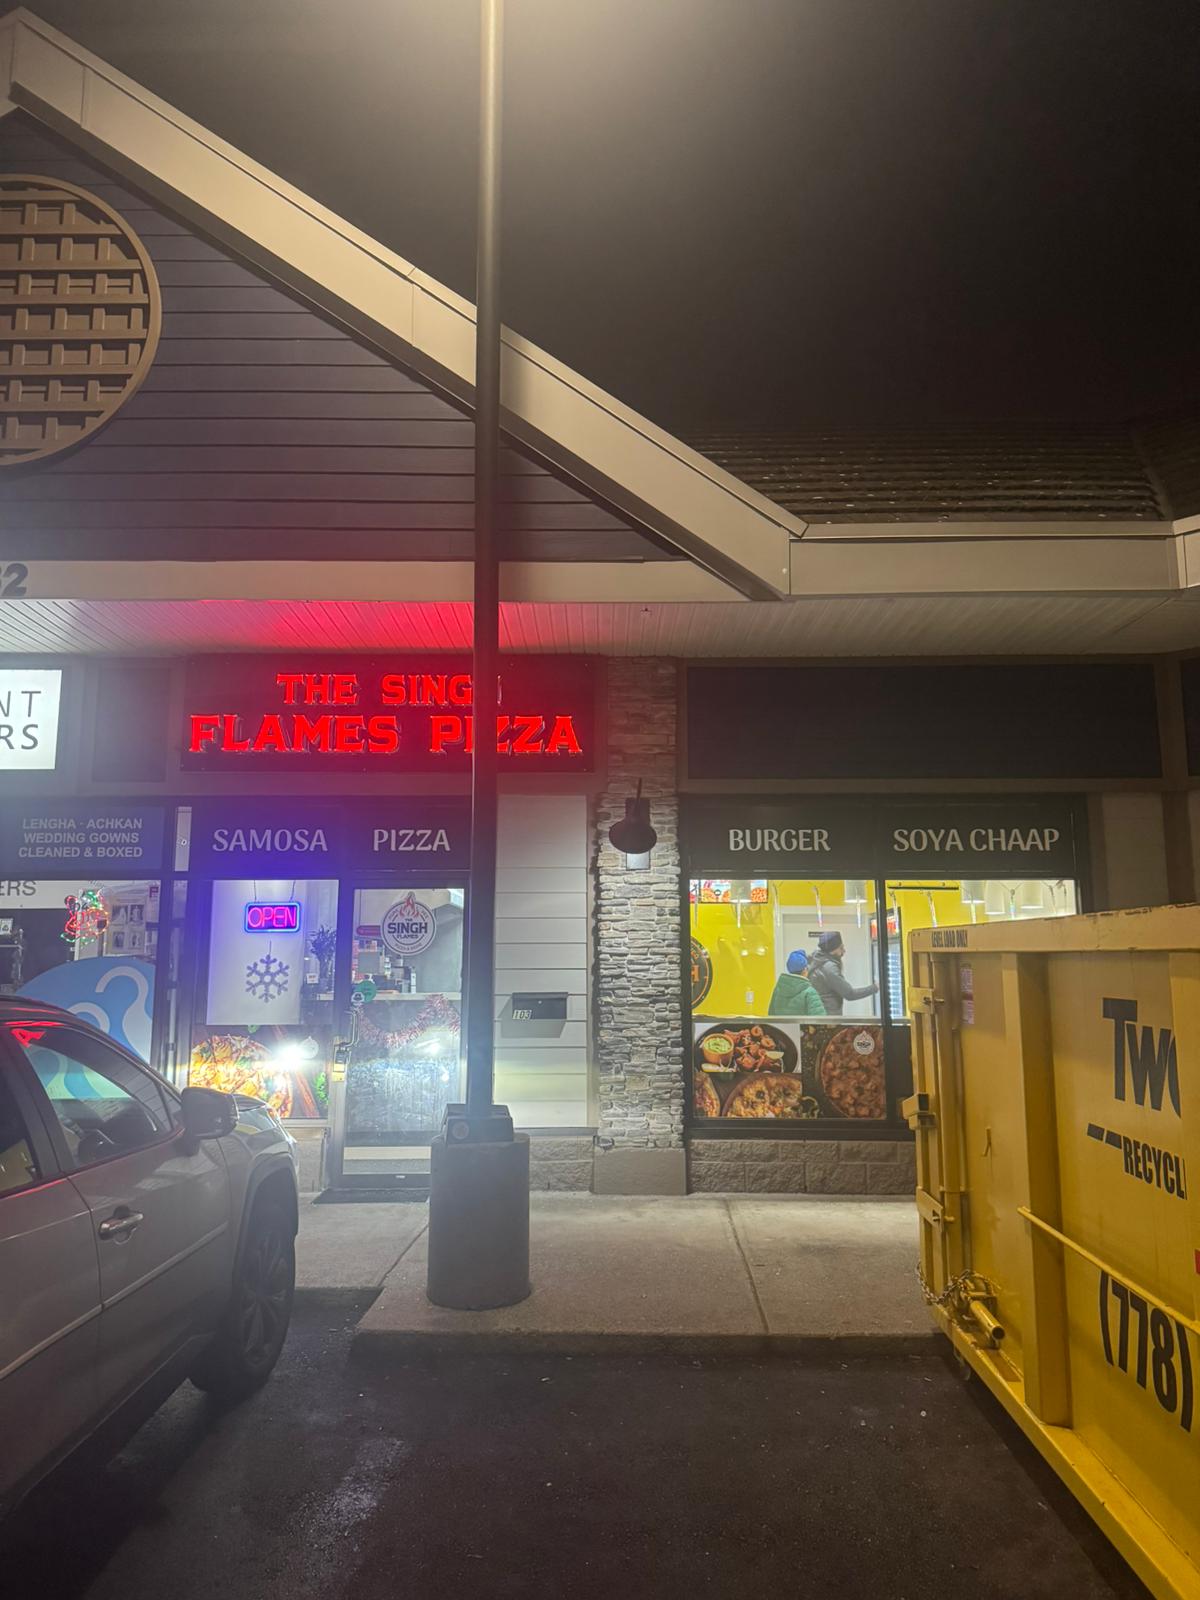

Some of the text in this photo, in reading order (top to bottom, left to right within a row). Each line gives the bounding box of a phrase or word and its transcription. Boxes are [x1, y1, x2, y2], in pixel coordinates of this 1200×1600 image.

[0, 563, 29, 597] 2
[276, 673, 502, 706] THE SING
[188, 714, 401, 755] FLAMES
[22, 818, 77, 830] LENGHA
[86, 818, 143, 830] ACHKAN
[23, 832, 140, 844] WEDDING GOWNS
[212, 828, 329, 853] SAMOSA
[373, 828, 451, 852] PIZZA
[728, 828, 831, 852] BURGER
[893, 828, 1060, 852] SOYA CHAAP
[18, 847, 143, 858] CLEANED & BOXED
[247, 906, 297, 928] OPEN
[387, 922, 428, 934] SINGH
[1100, 1269, 1194, 1433] (778)
